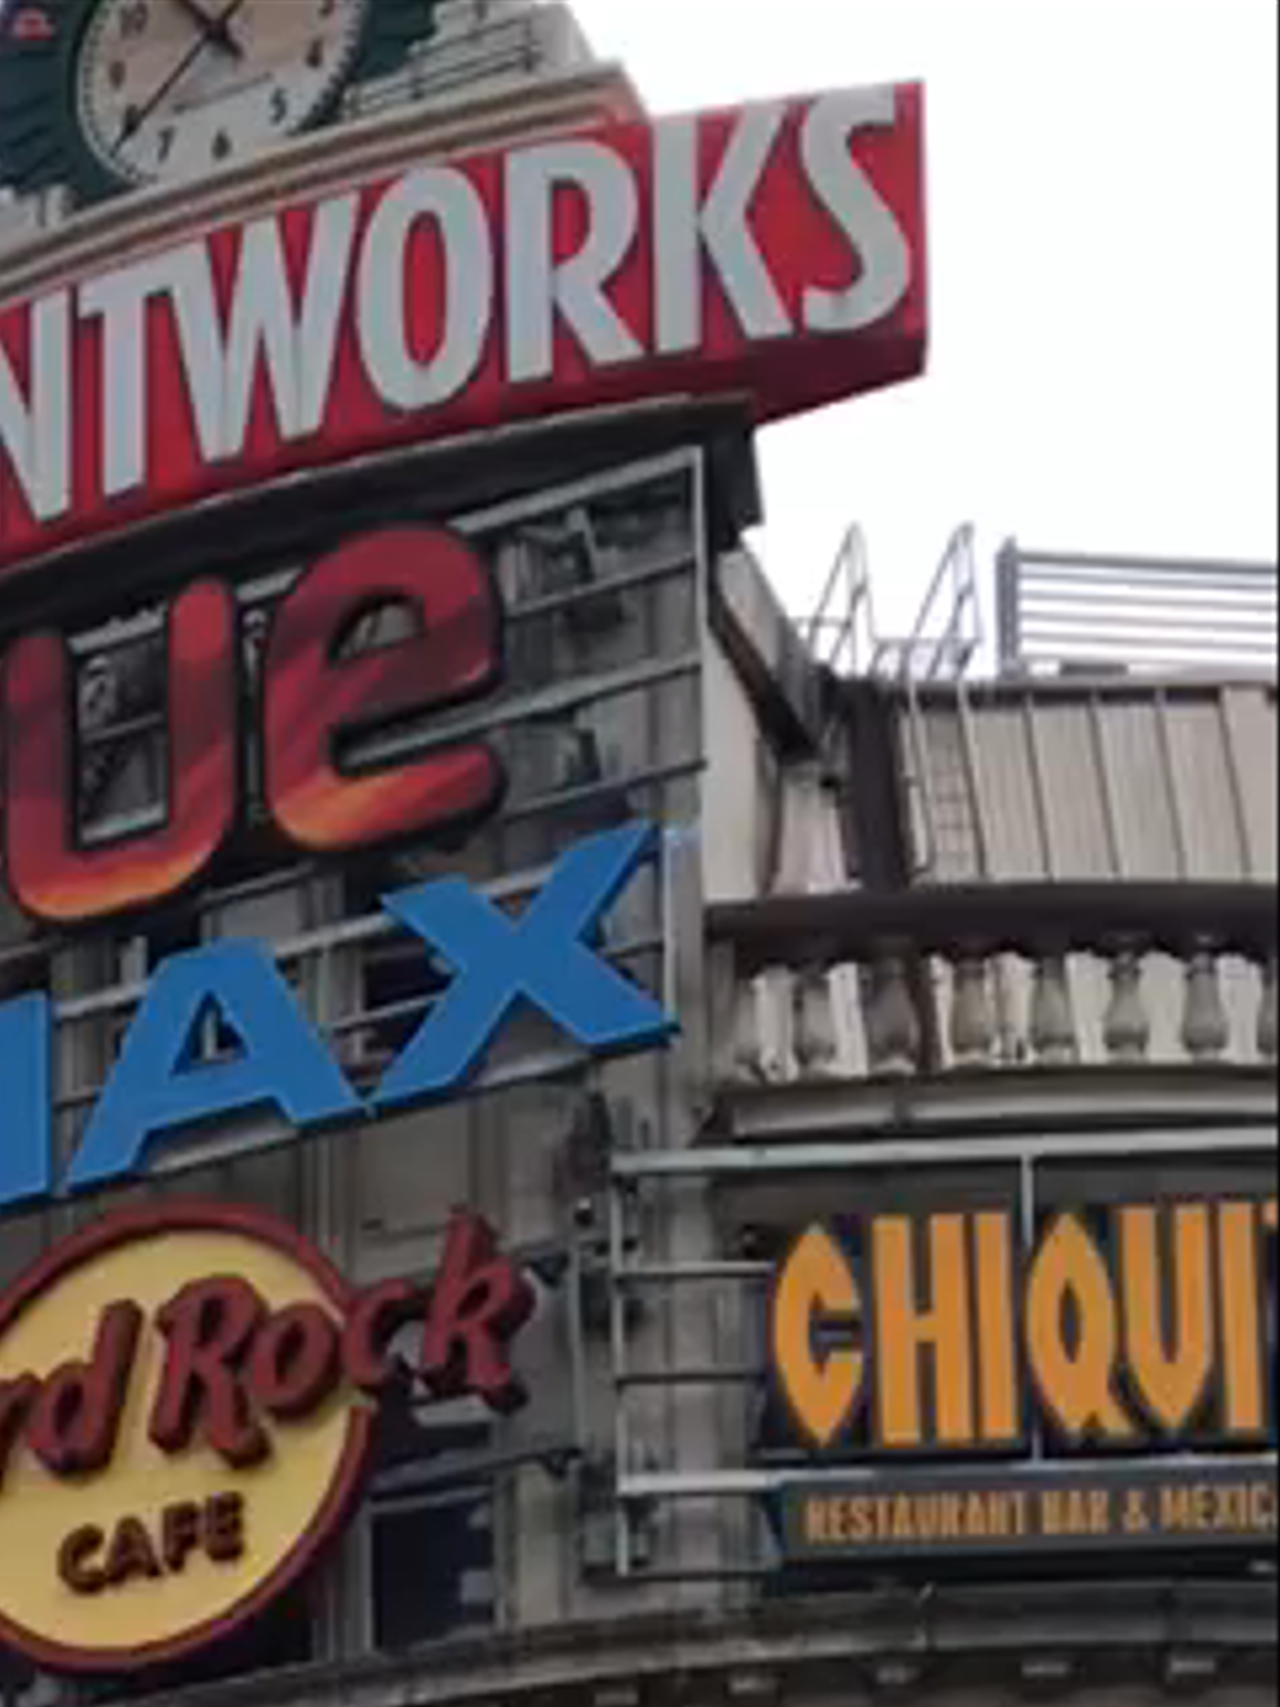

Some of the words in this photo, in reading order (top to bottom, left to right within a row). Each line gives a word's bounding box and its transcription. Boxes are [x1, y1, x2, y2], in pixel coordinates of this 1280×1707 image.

[146, 1206, 540, 1466] Rock
[774, 1200, 1279, 1448] CHIQUI
[57, 1492, 248, 1598] CAFE
[807, 1492, 1024, 1542] RESTAURANT
[1042, 1488, 1108, 1535] BAR
